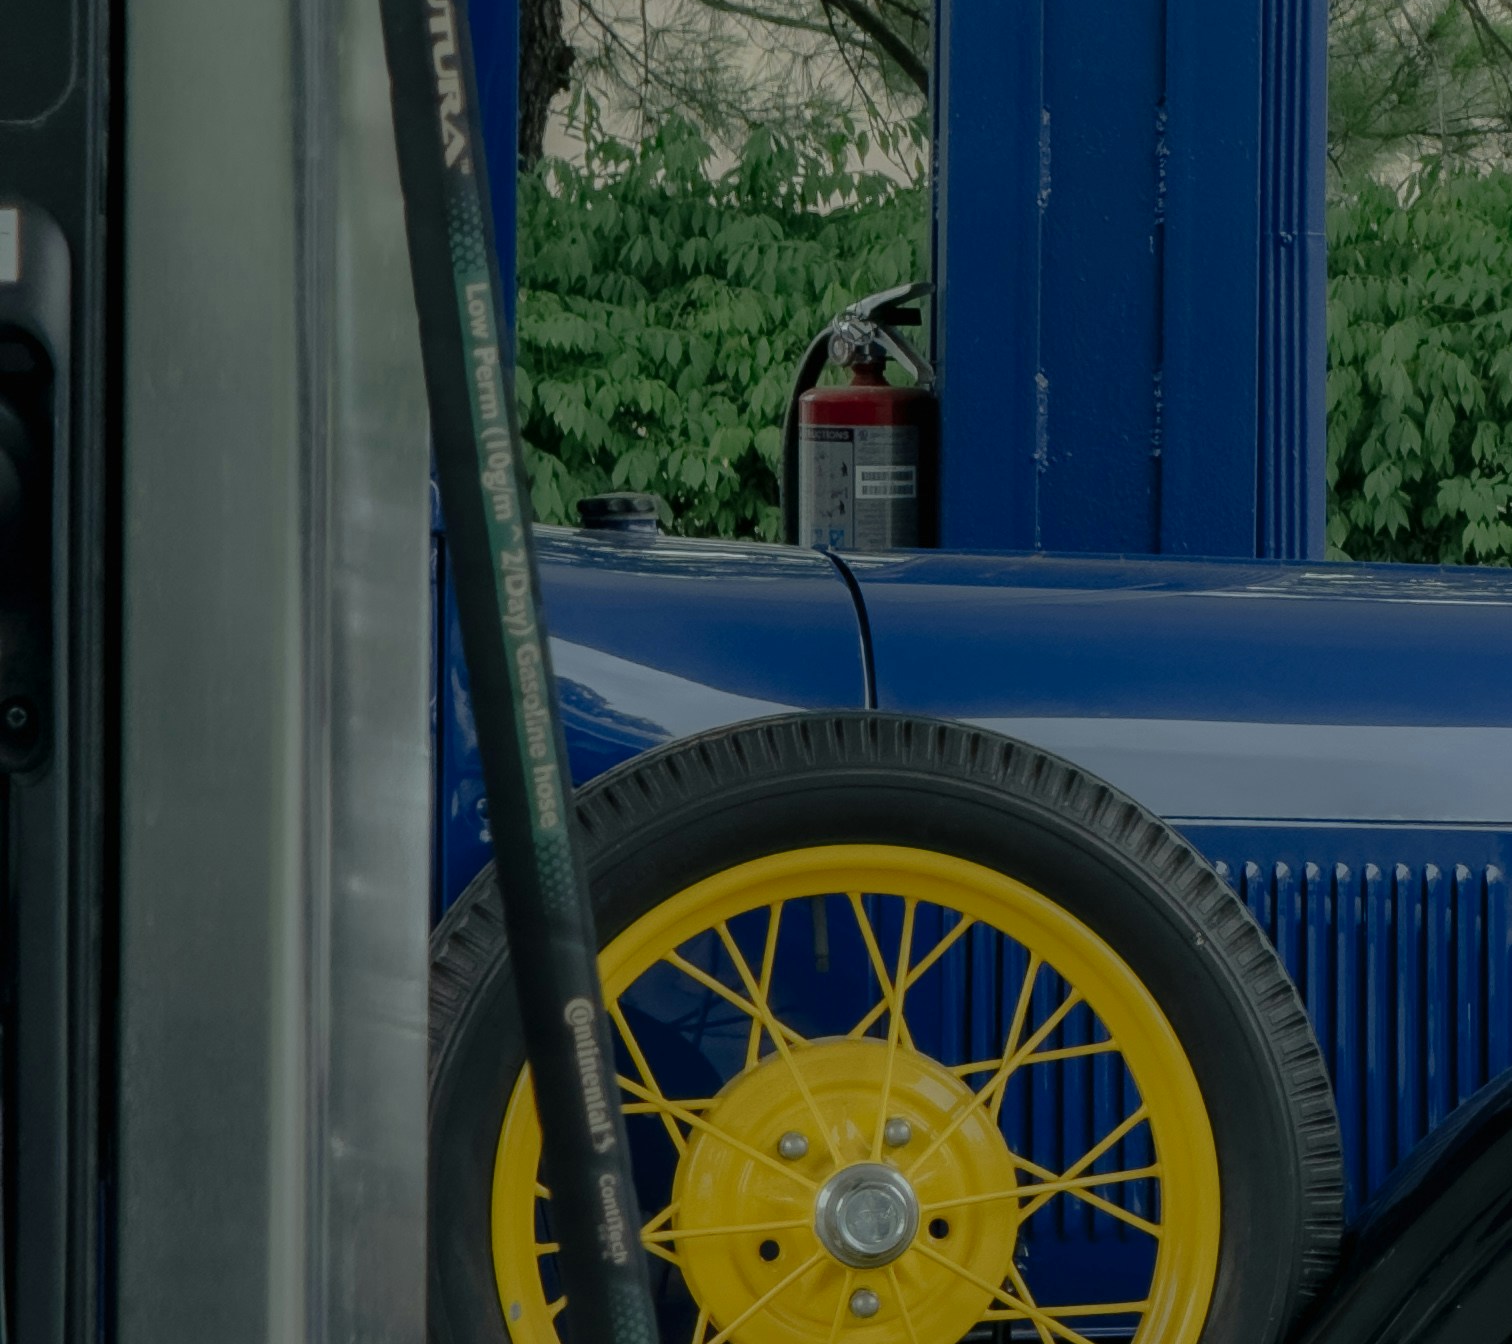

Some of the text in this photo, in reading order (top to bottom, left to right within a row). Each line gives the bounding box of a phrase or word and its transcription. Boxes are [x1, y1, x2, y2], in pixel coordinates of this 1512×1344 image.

[465, 281, 489, 339] Low
[473, 346, 499, 422] Perm
[516, 643, 547, 759] Gasoline
[531, 764, 561, 830] hose
[564, 997, 607, 1136] Continental
